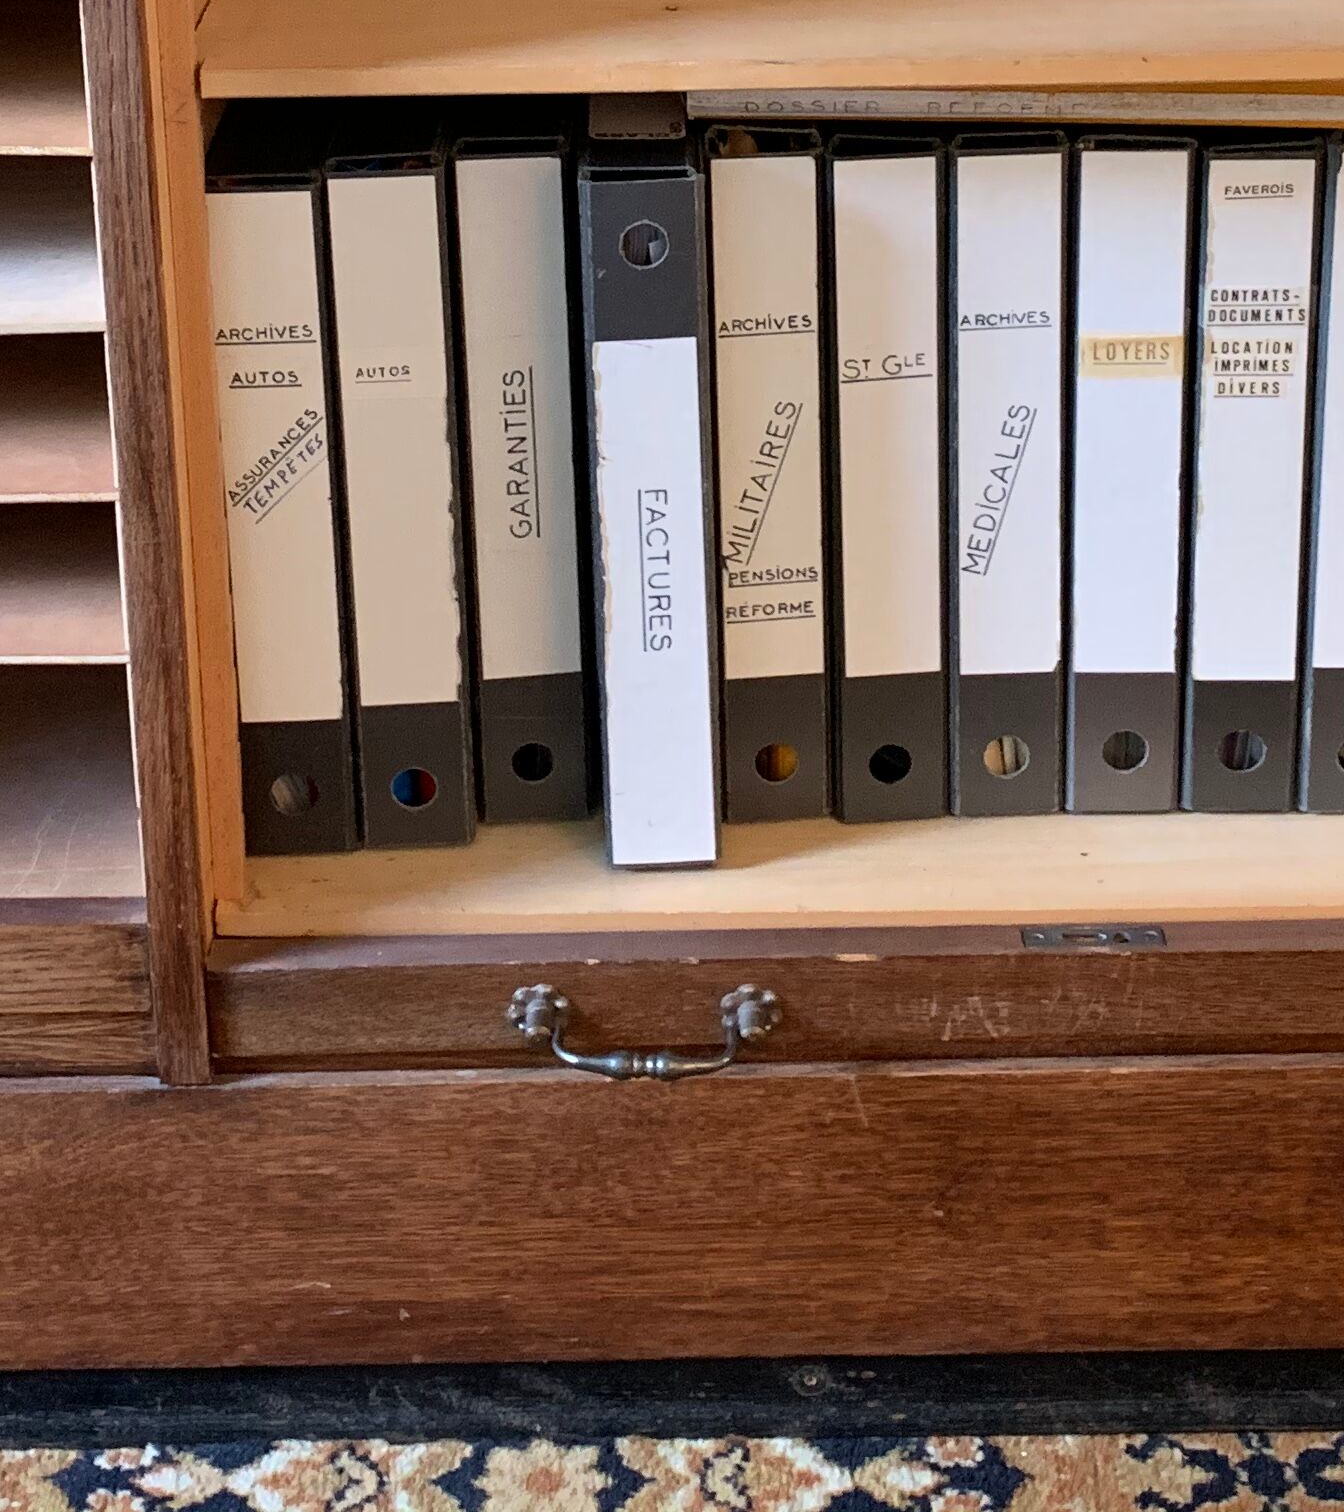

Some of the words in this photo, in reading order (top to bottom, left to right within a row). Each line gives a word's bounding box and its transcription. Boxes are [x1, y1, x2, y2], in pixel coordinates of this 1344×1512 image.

[1224, 182, 1294, 195] FAVEROIS
[719, 313, 812, 333] ARCHIVES
[960, 309, 1050, 327] ARCHIVES
[1208, 308, 1306, 322] DOCUMENTS
[216, 323, 313, 341] ARCHIVES
[1093, 342, 1170, 361] LOYERS
[1211, 339, 1293, 354] LOCATION
[356, 364, 410, 378] AUTOS
[1214, 356, 1290, 372] IMPRIMES
[231, 370, 299, 384] AUTOS
[1217, 378, 1280, 394] DIVERS
[228, 408, 319, 502] ASSURANCES
[499, 369, 532, 539] GARANTIES
[726, 401, 797, 563] MILITAIRES
[961, 404, 1030, 574] MEDICALES
[645, 488, 673, 653] FACTURES
[729, 565, 818, 585] PENSIONS
